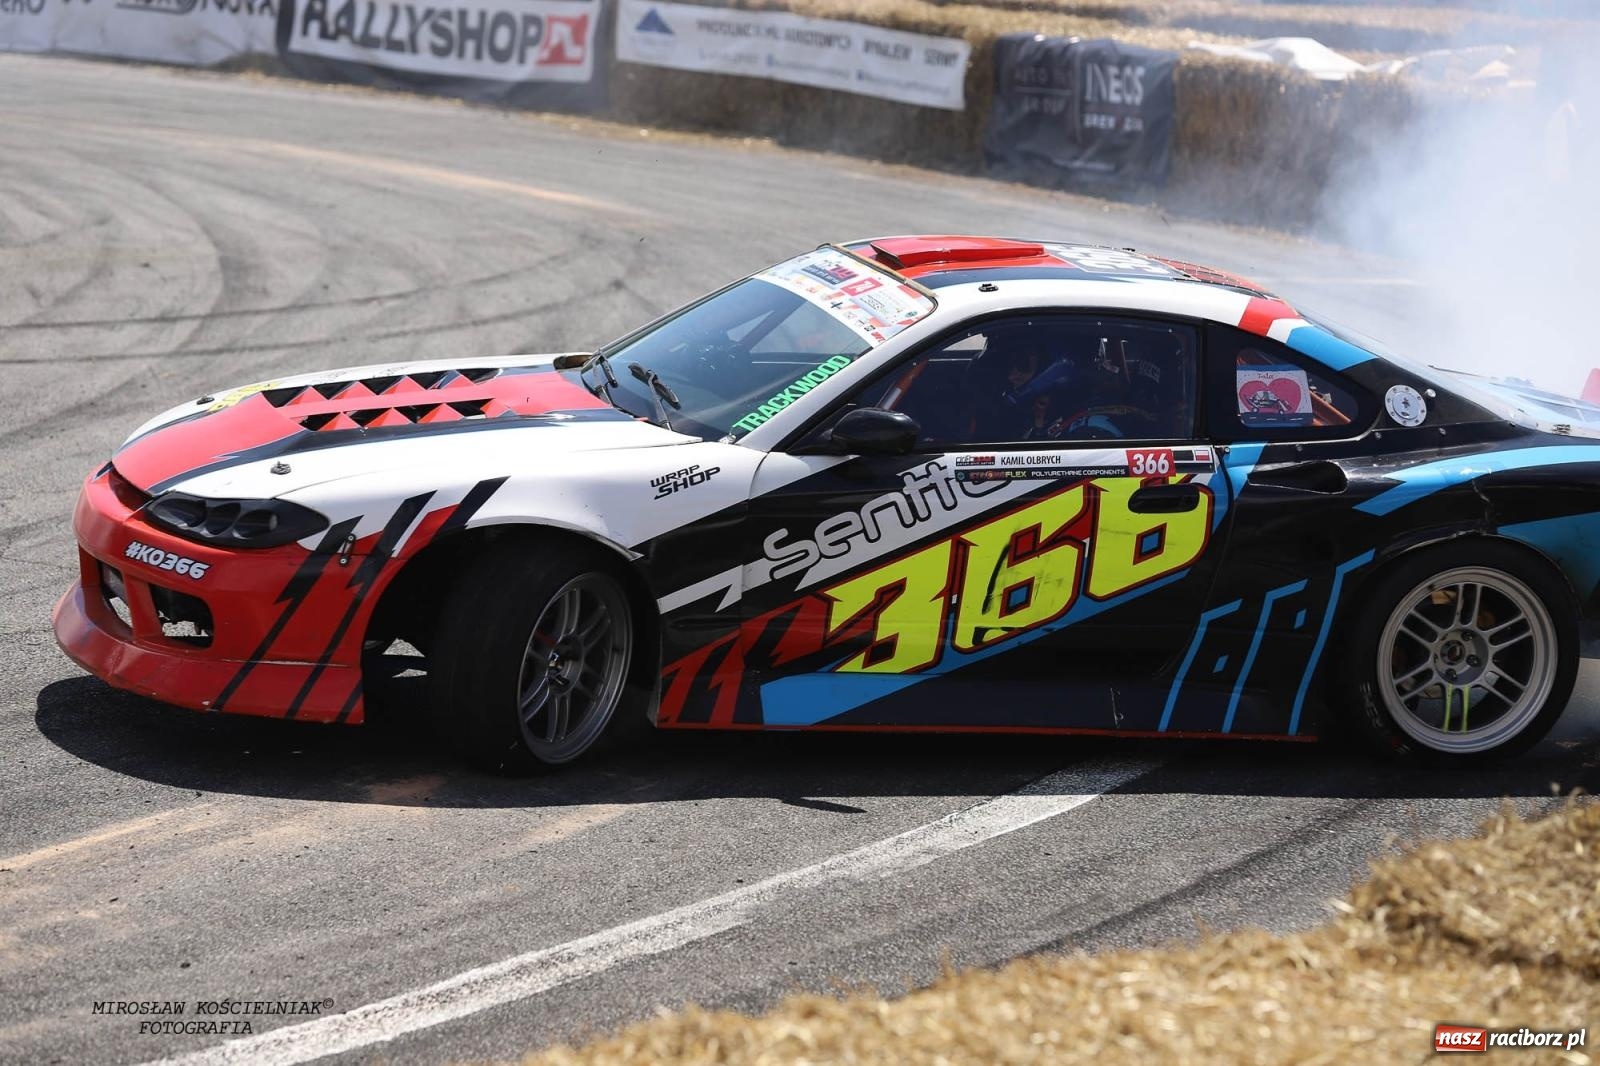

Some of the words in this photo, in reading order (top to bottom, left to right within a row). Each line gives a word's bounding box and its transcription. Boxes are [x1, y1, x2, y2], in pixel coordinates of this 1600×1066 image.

[302, 0, 544, 65] RALLYSHOP
[731, 355, 852, 432] TRACKWOOD
[1000, 456, 1025, 465] KAMIL
[1026, 455, 1061, 465] OLBRYCH
[1082, 468, 1126, 476] COMPONENTS
[1132, 453, 1170, 474] 366
[650, 464, 700, 487] WRAP
[654, 466, 720, 500] SHOP
[820, 474, 1214, 675] 366
